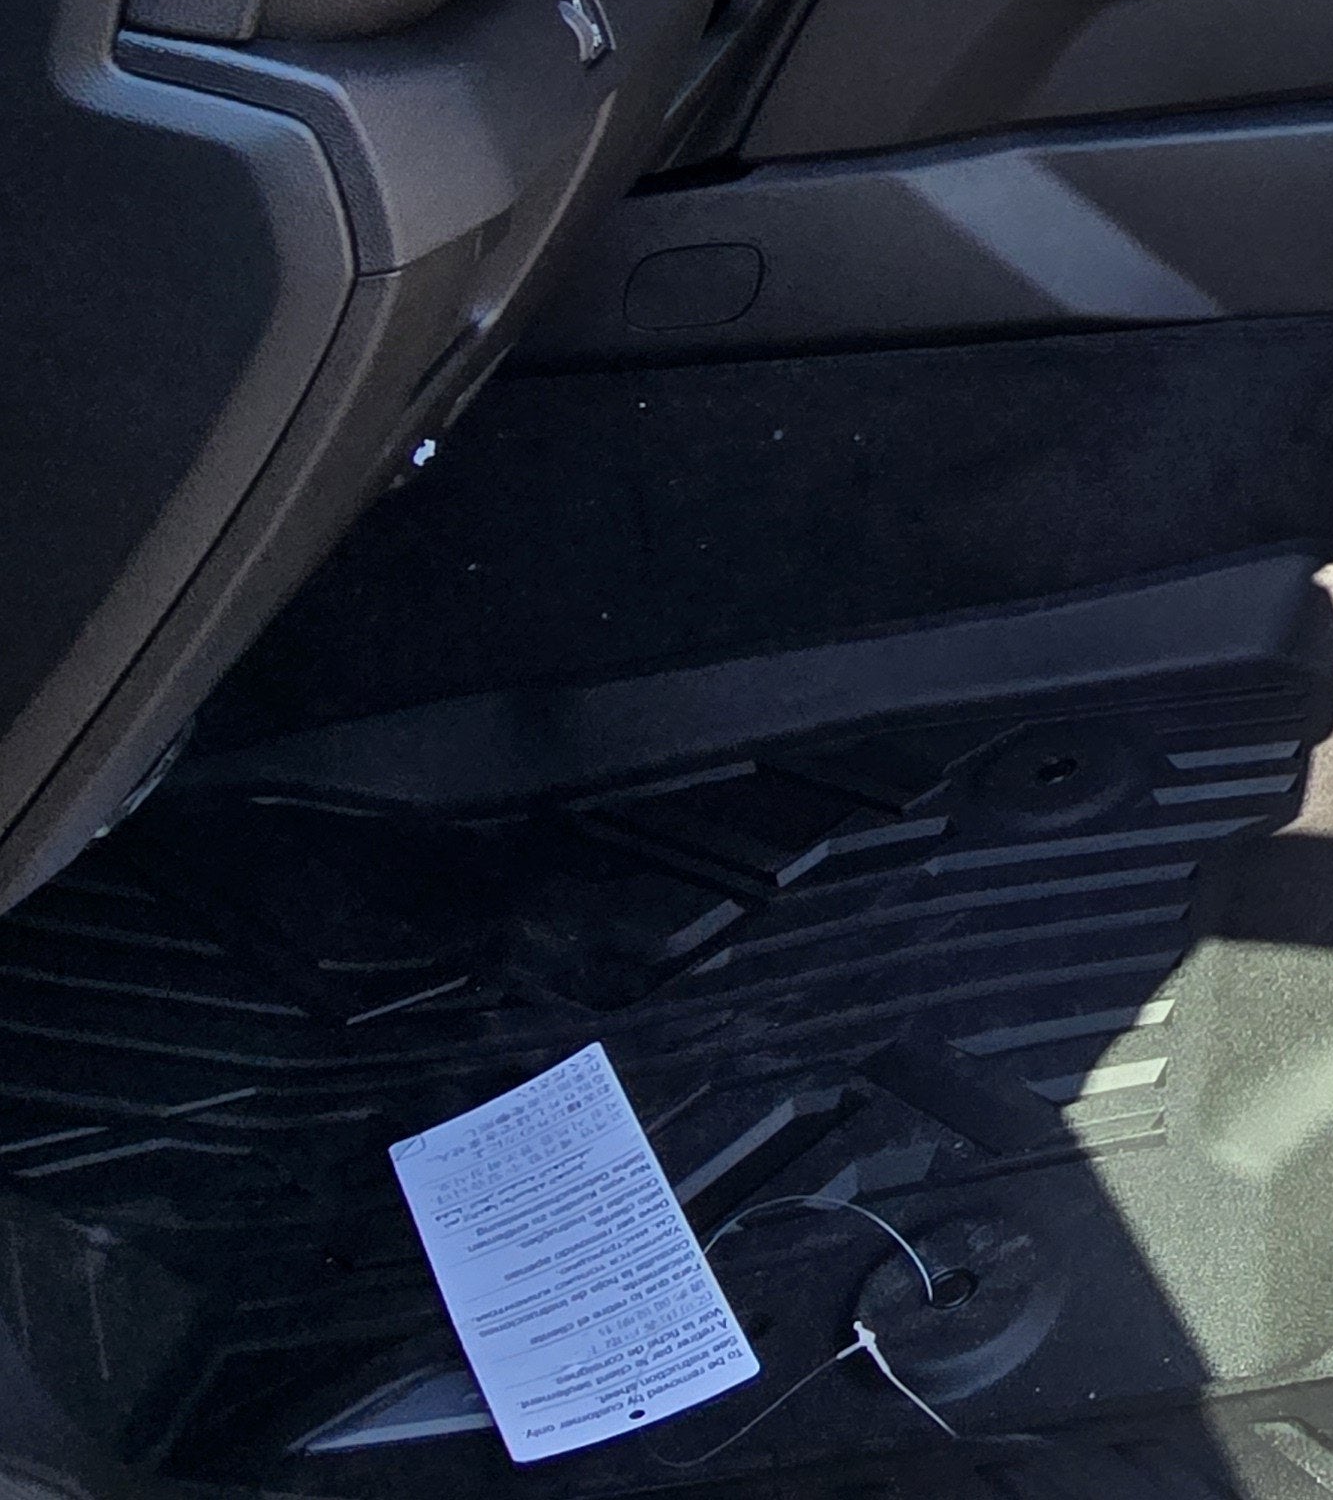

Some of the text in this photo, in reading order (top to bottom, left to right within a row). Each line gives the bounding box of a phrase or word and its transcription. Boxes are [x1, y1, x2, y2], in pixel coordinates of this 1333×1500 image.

[642, 1276, 670, 1294] que
[569, 1289, 588, 1304] de
[590, 1298, 628, 1320] retire
[694, 1306, 724, 1325] Voir
[680, 1320, 696, 1333] la
[673, 1324, 717, 1349] retirer
[625, 1344, 645, 1358] de
[648, 1344, 674, 1361] par
[594, 1363, 632, 1385] client
[637, 1350, 711, 1386] instruction
[520, 1347, 743, 1442] To be removed by customer only.
